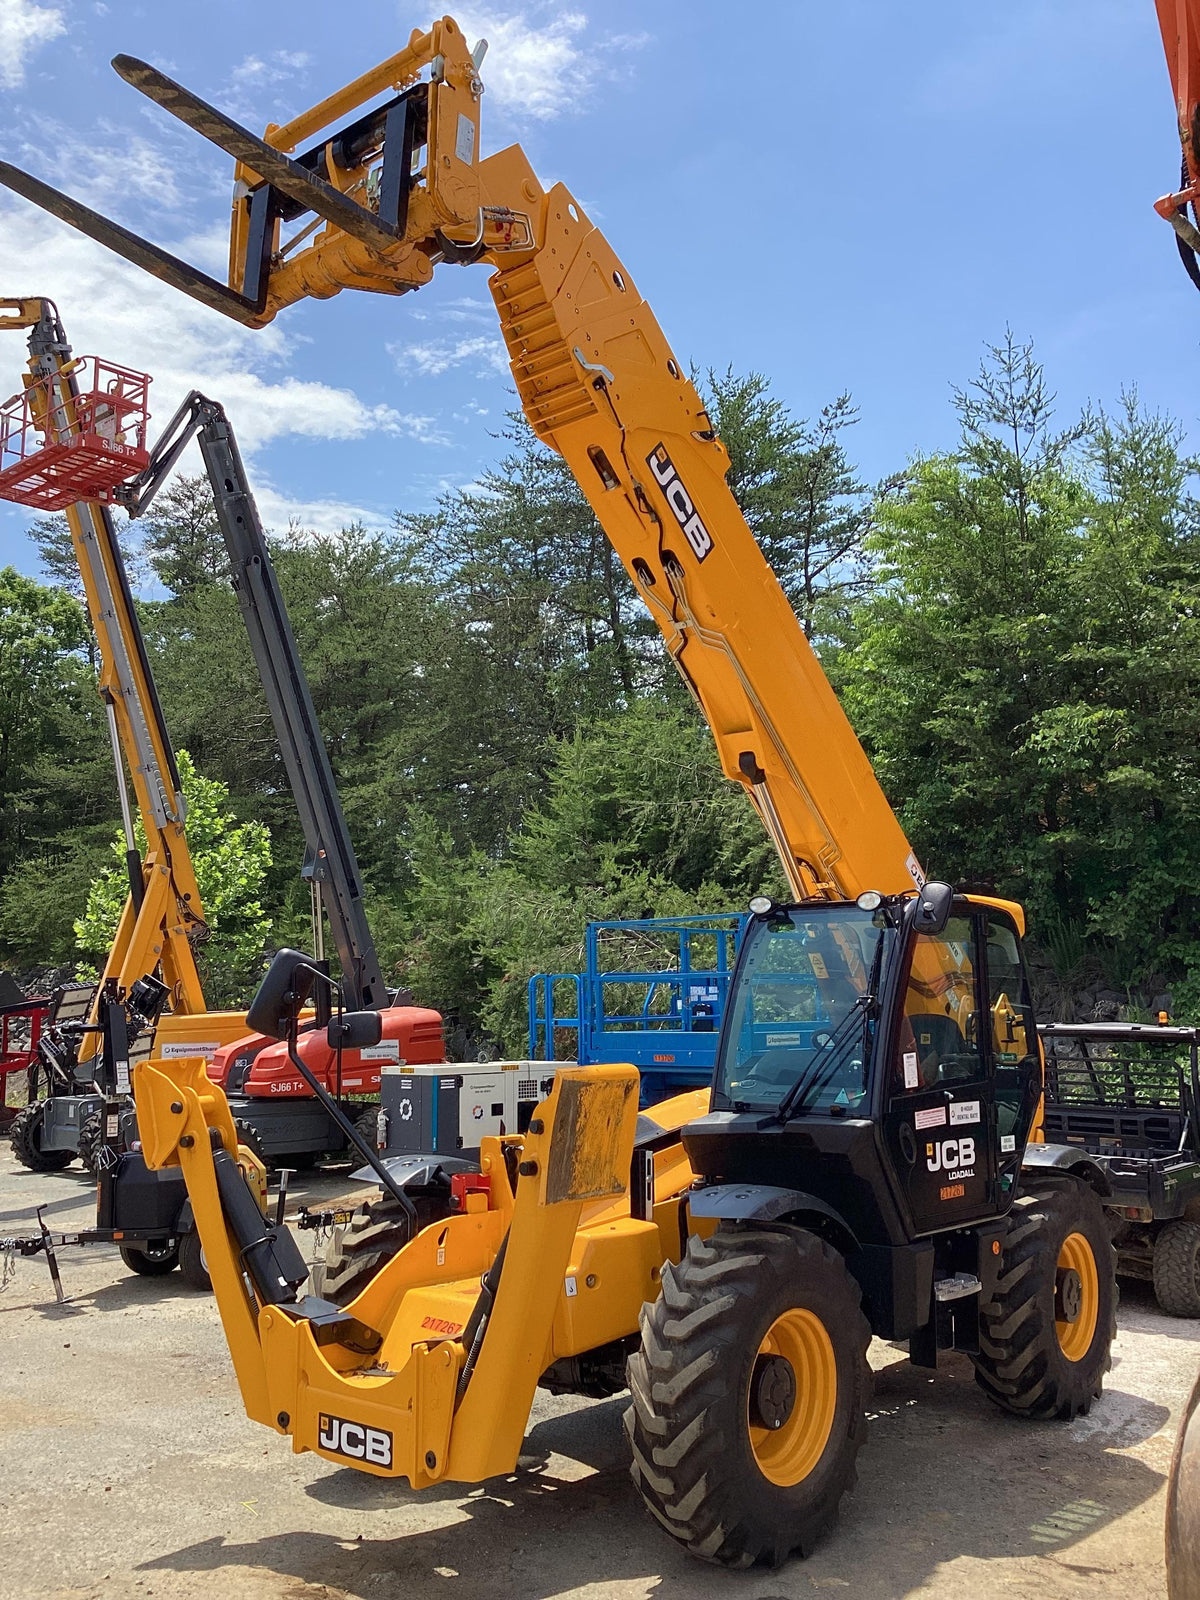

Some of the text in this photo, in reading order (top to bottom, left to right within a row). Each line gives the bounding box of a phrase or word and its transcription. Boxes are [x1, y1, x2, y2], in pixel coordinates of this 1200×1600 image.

[125, 446, 136, 456] T+
[649, 454, 711, 558] JCB
[270, 1081, 304, 1093] SJ66 T+
[927, 1137, 976, 1172] JCB
[948, 1168, 975, 1180] LOADALL
[421, 1316, 463, 1334] 217267
[320, 1418, 391, 1465] JCB
